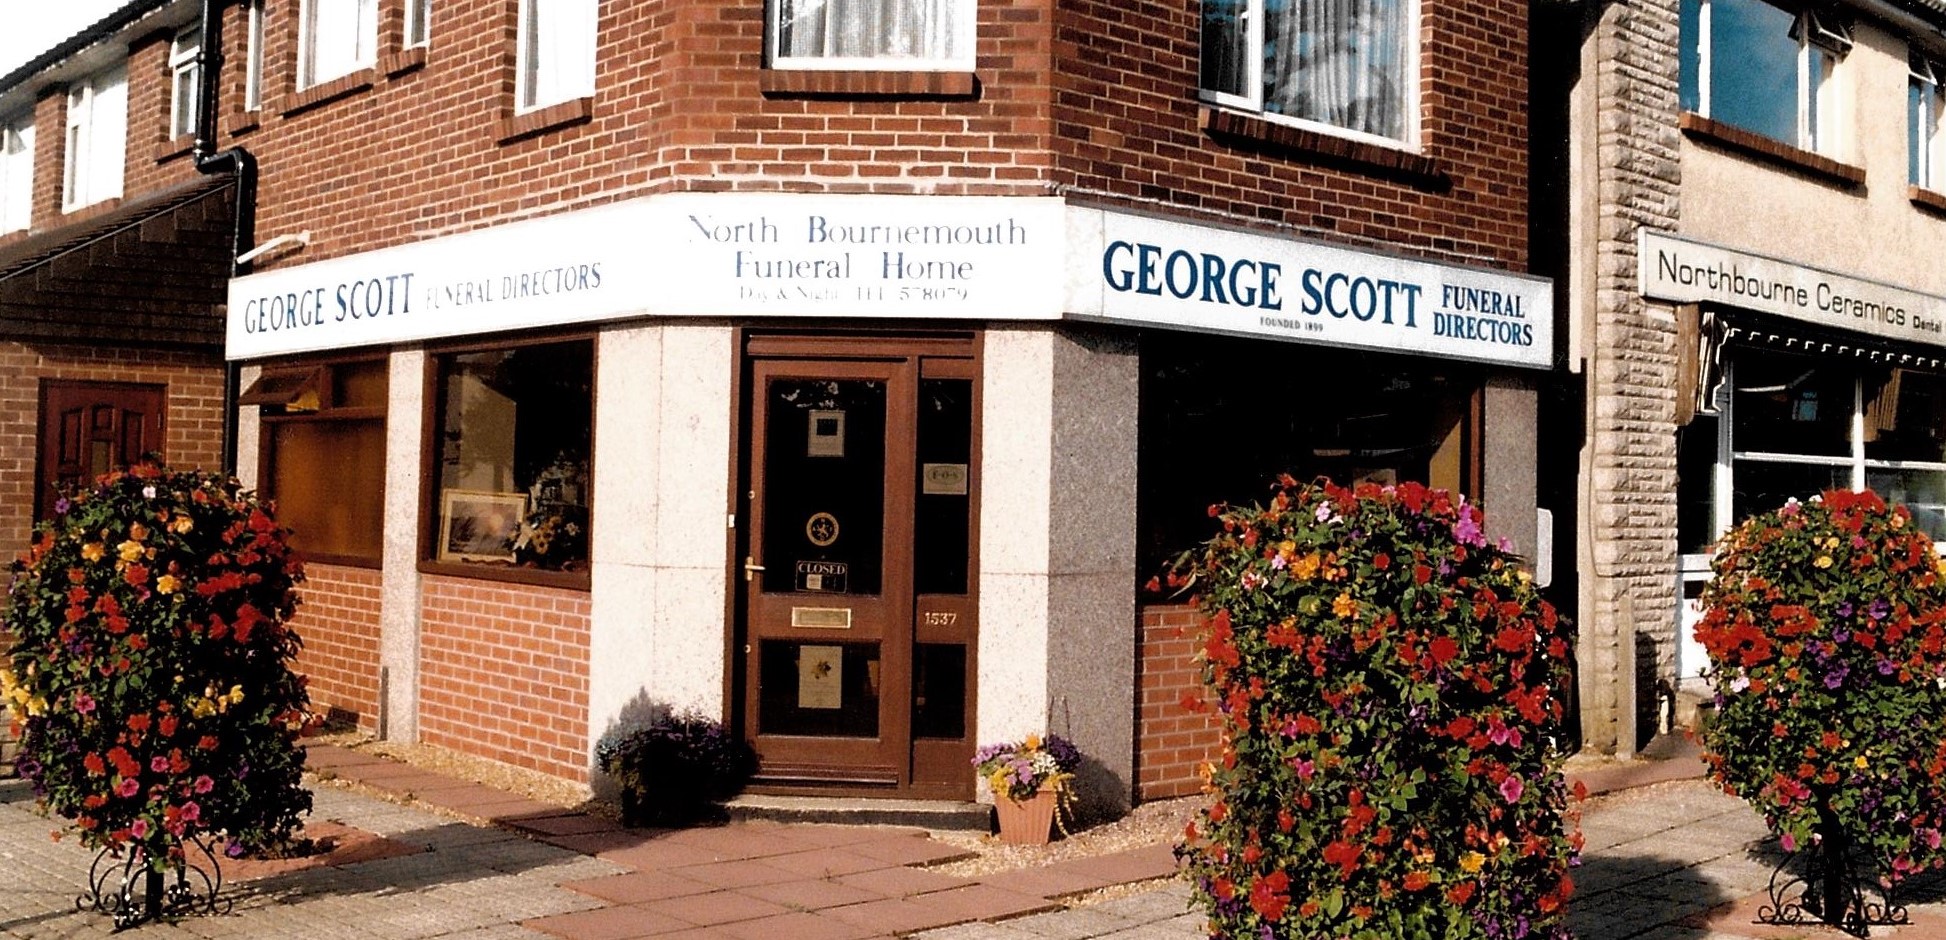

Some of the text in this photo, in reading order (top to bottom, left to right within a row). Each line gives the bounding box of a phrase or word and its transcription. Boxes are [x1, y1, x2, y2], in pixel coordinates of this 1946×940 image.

[689, 215, 1027, 245] North Bournemouth
[735, 251, 975, 280] Funeral Home
[426, 262, 602, 310] FUNERAL DIRECTORS
[776, 287, 788, 300] &
[1102, 239, 1423, 329] GEORGE SCOTT
[1658, 249, 1808, 307] Northbourne
[1816, 282, 1906, 327] Ceramics
[244, 273, 415, 334] GEORGE SCOTT
[1441, 283, 1527, 319] FUNERAL
[1259, 316, 1301, 330] FOUNDED
[1433, 311, 1533, 347] DIRECTORS
[798, 562, 846, 576] CLOSED
[924, 611, 958, 626] 1537
